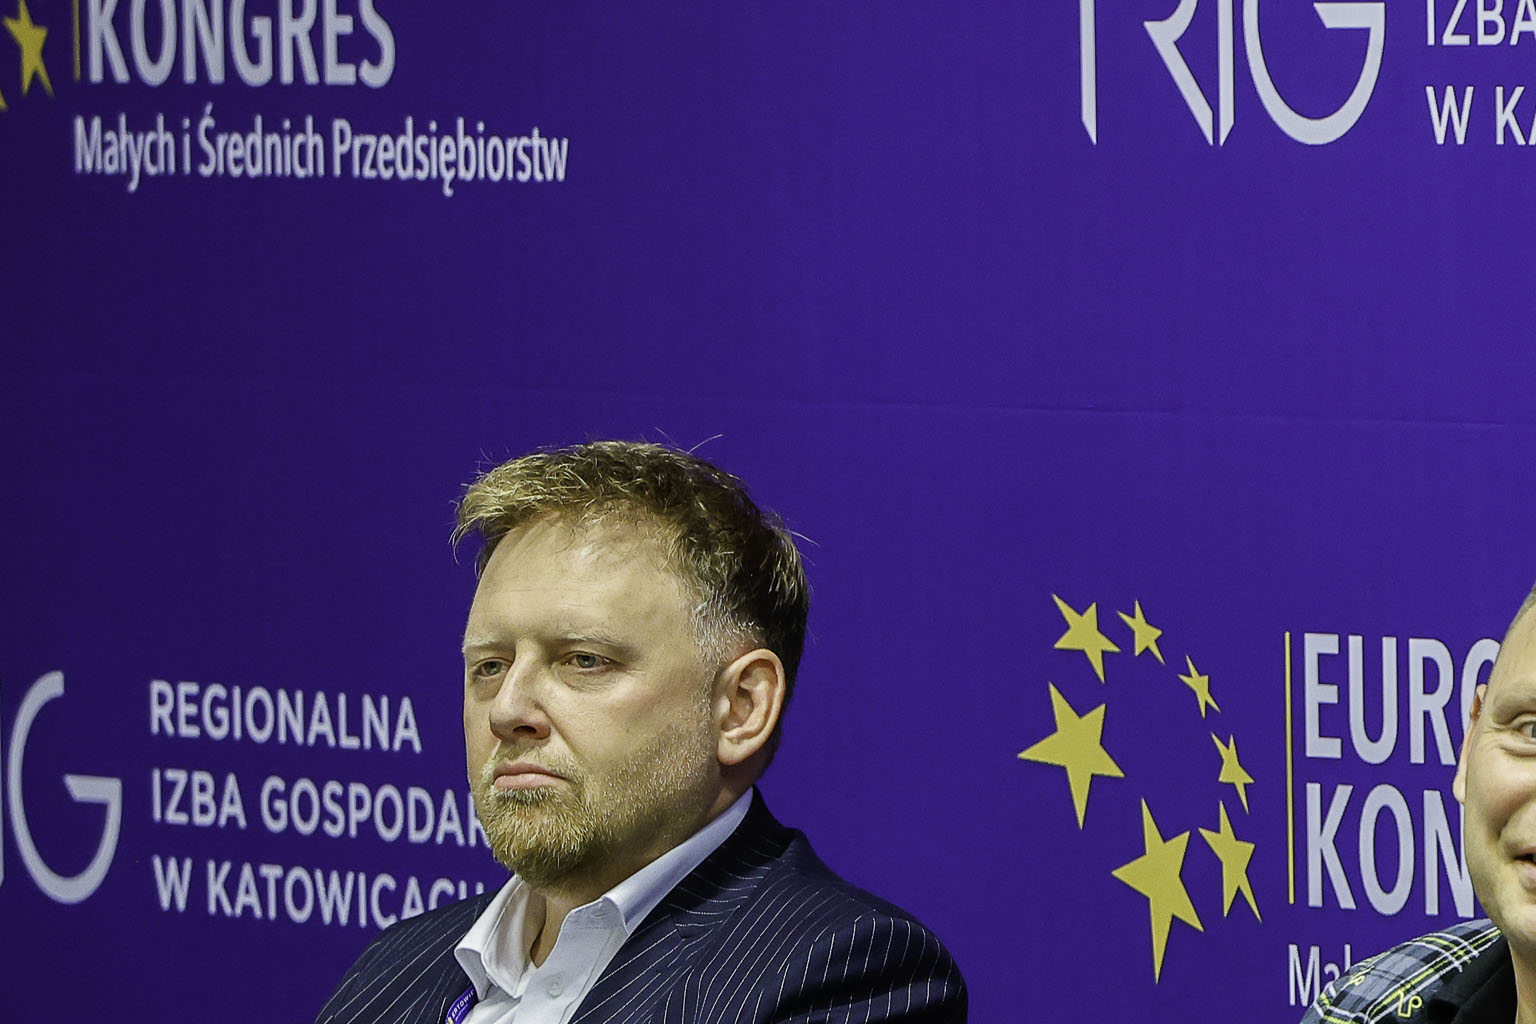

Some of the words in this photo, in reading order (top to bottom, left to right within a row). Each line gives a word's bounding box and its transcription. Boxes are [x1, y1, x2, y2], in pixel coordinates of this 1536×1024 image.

[88, 0, 396, 88] KONGRES
[1425, 85, 1475, 145] W
[75, 114, 175, 192] Małych
[183, 118, 191, 175] i
[199, 103, 325, 178] Średnich
[333, 116, 569, 197] Przedsiębiorstw
[150, 680, 422, 754] REGIONALNA
[152, 768, 247, 830] IZBA
[153, 855, 192, 912] W
